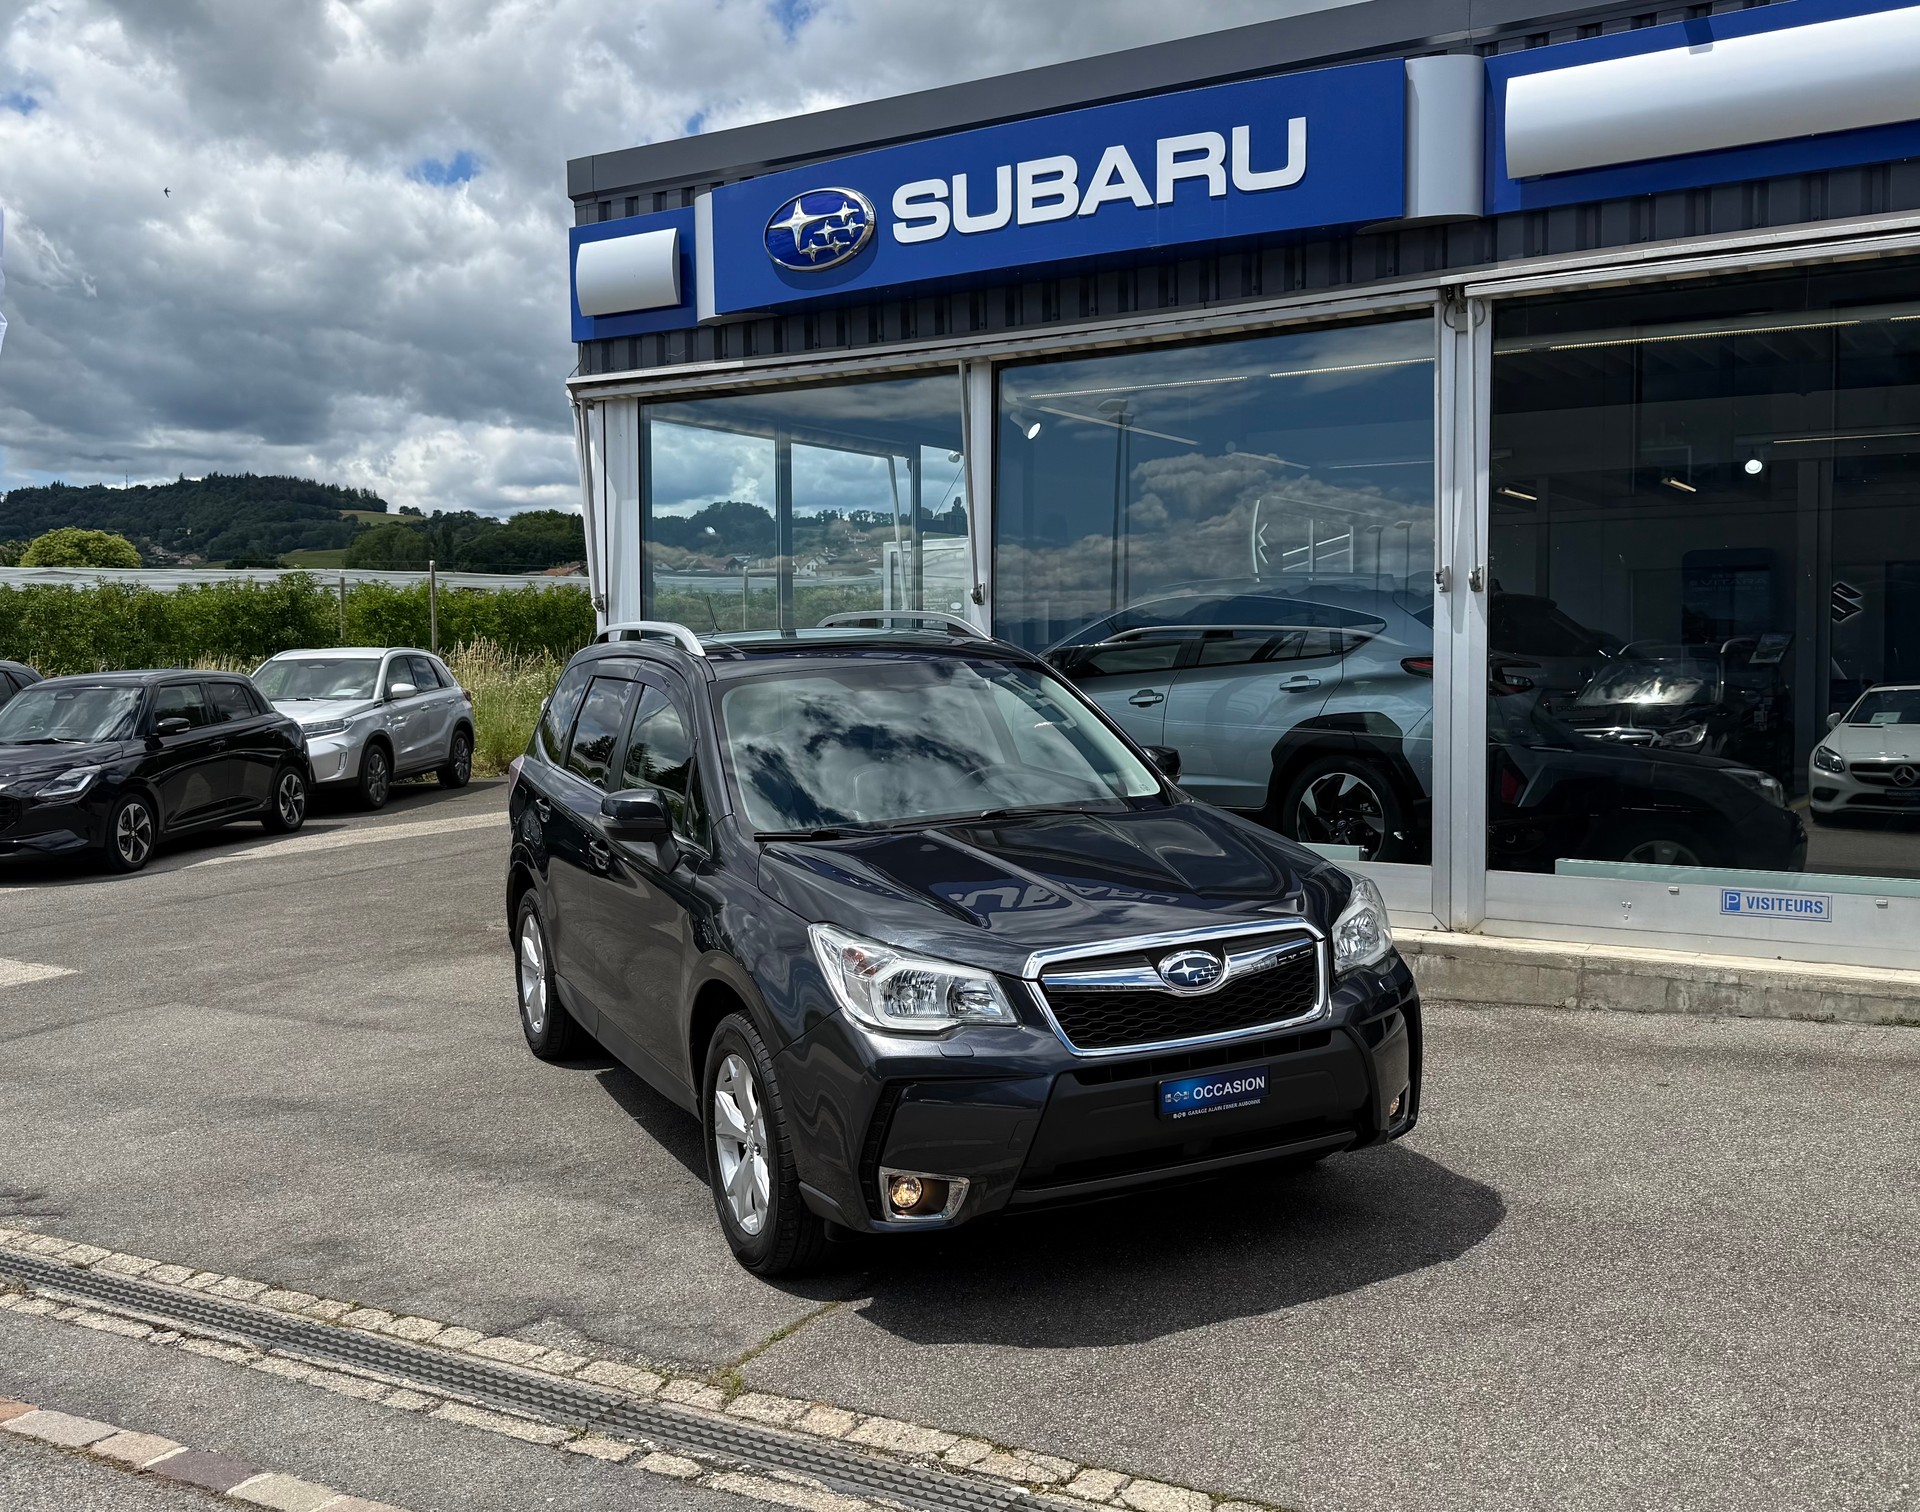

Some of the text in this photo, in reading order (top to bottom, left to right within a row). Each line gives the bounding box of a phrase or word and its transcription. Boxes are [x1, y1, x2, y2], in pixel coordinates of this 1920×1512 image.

[892, 116, 1307, 244] SUBARU
[1726, 893, 1823, 913] P VISITEURS
[1193, 1076, 1265, 1099] OCCASION
[1187, 1108, 1208, 1116] GARAGE
